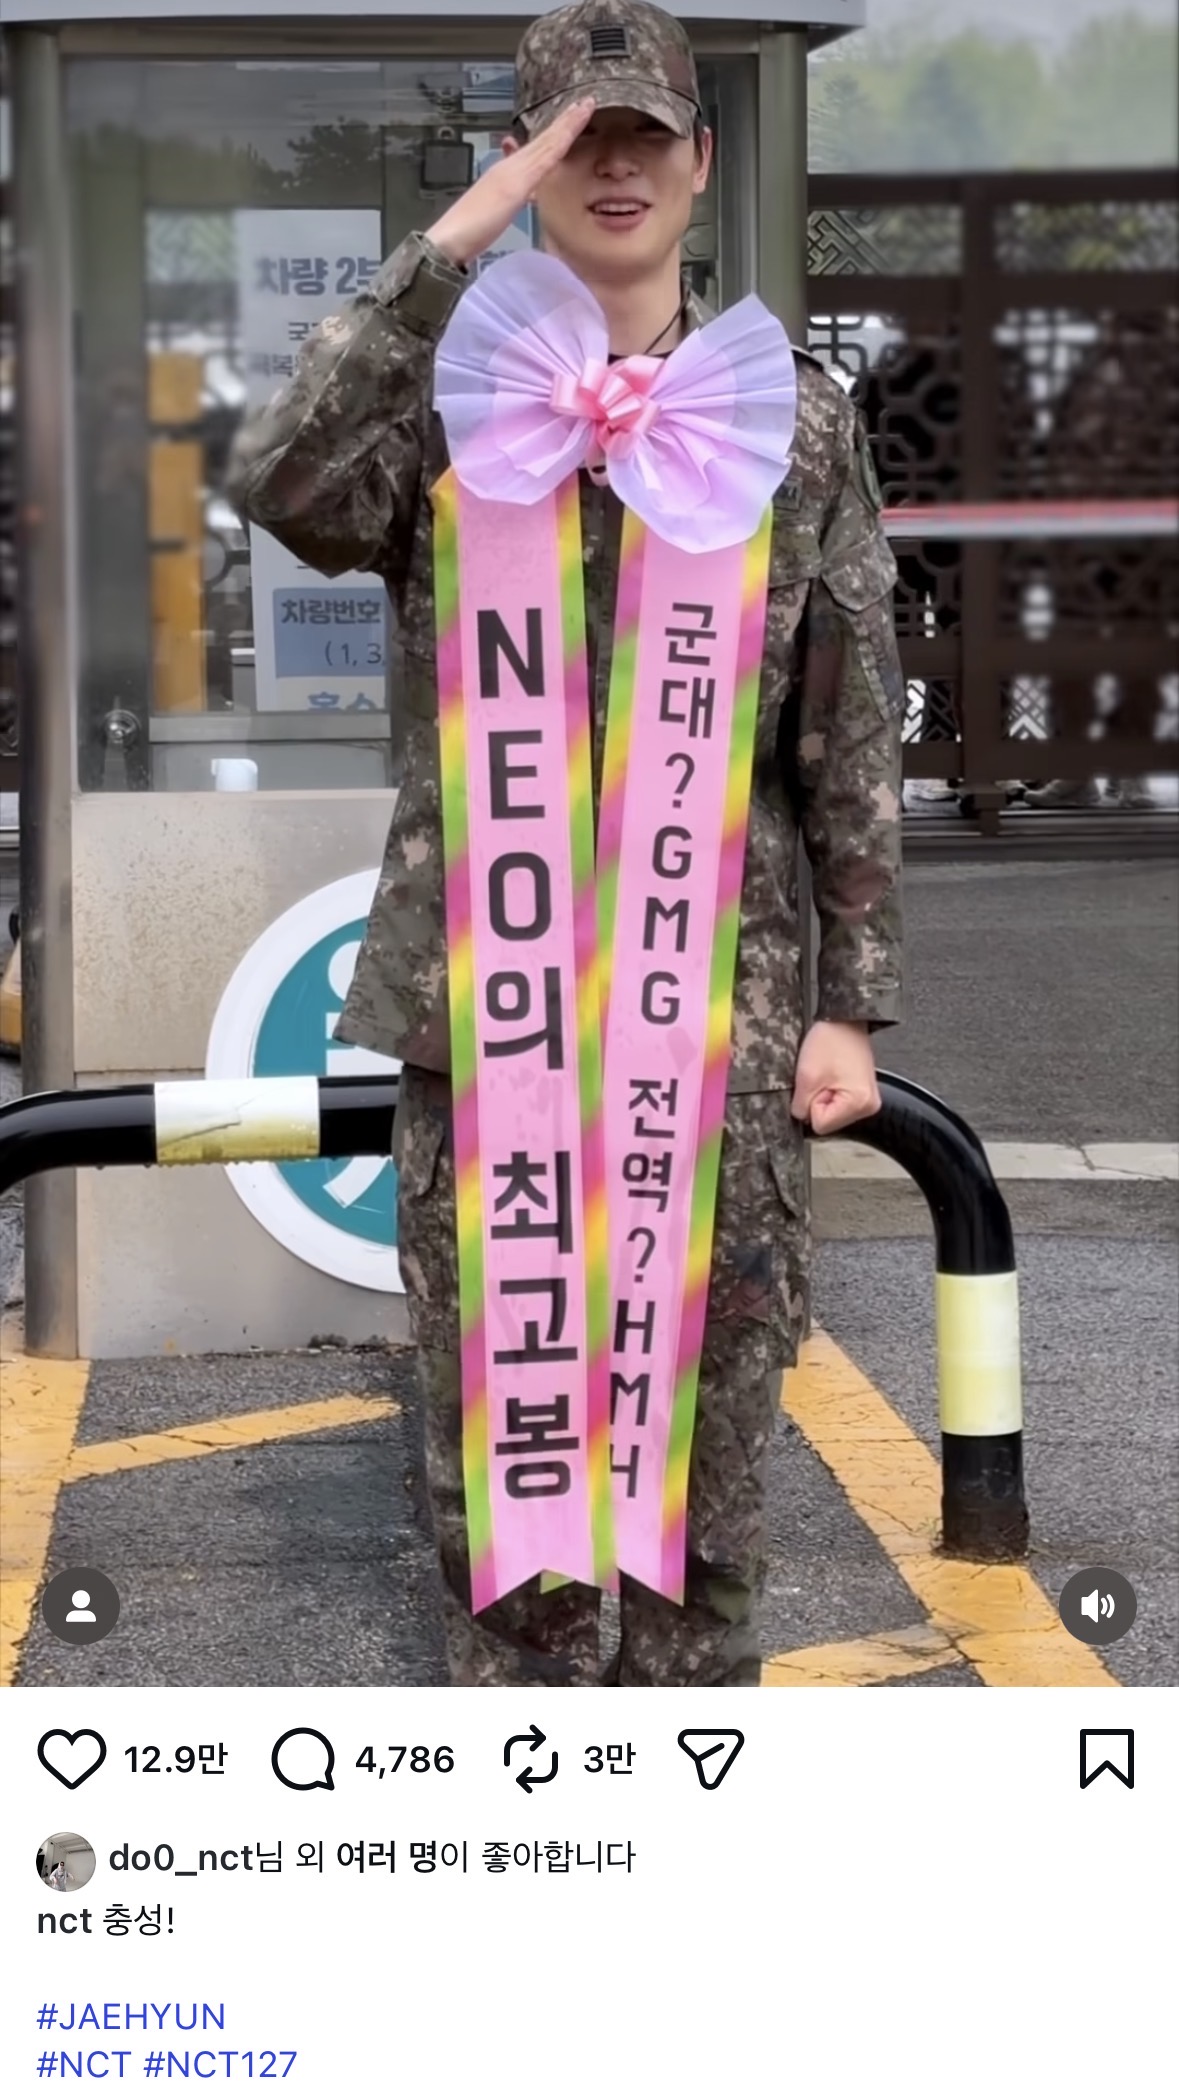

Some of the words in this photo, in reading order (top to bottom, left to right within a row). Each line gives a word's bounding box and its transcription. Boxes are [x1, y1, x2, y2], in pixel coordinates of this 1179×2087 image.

[256, 257, 328, 295] 차량
[281, 599, 381, 624] 차량번호
[477, 608, 563, 1069] NEO의
[490, 1151, 580, 1499] 최고봉
